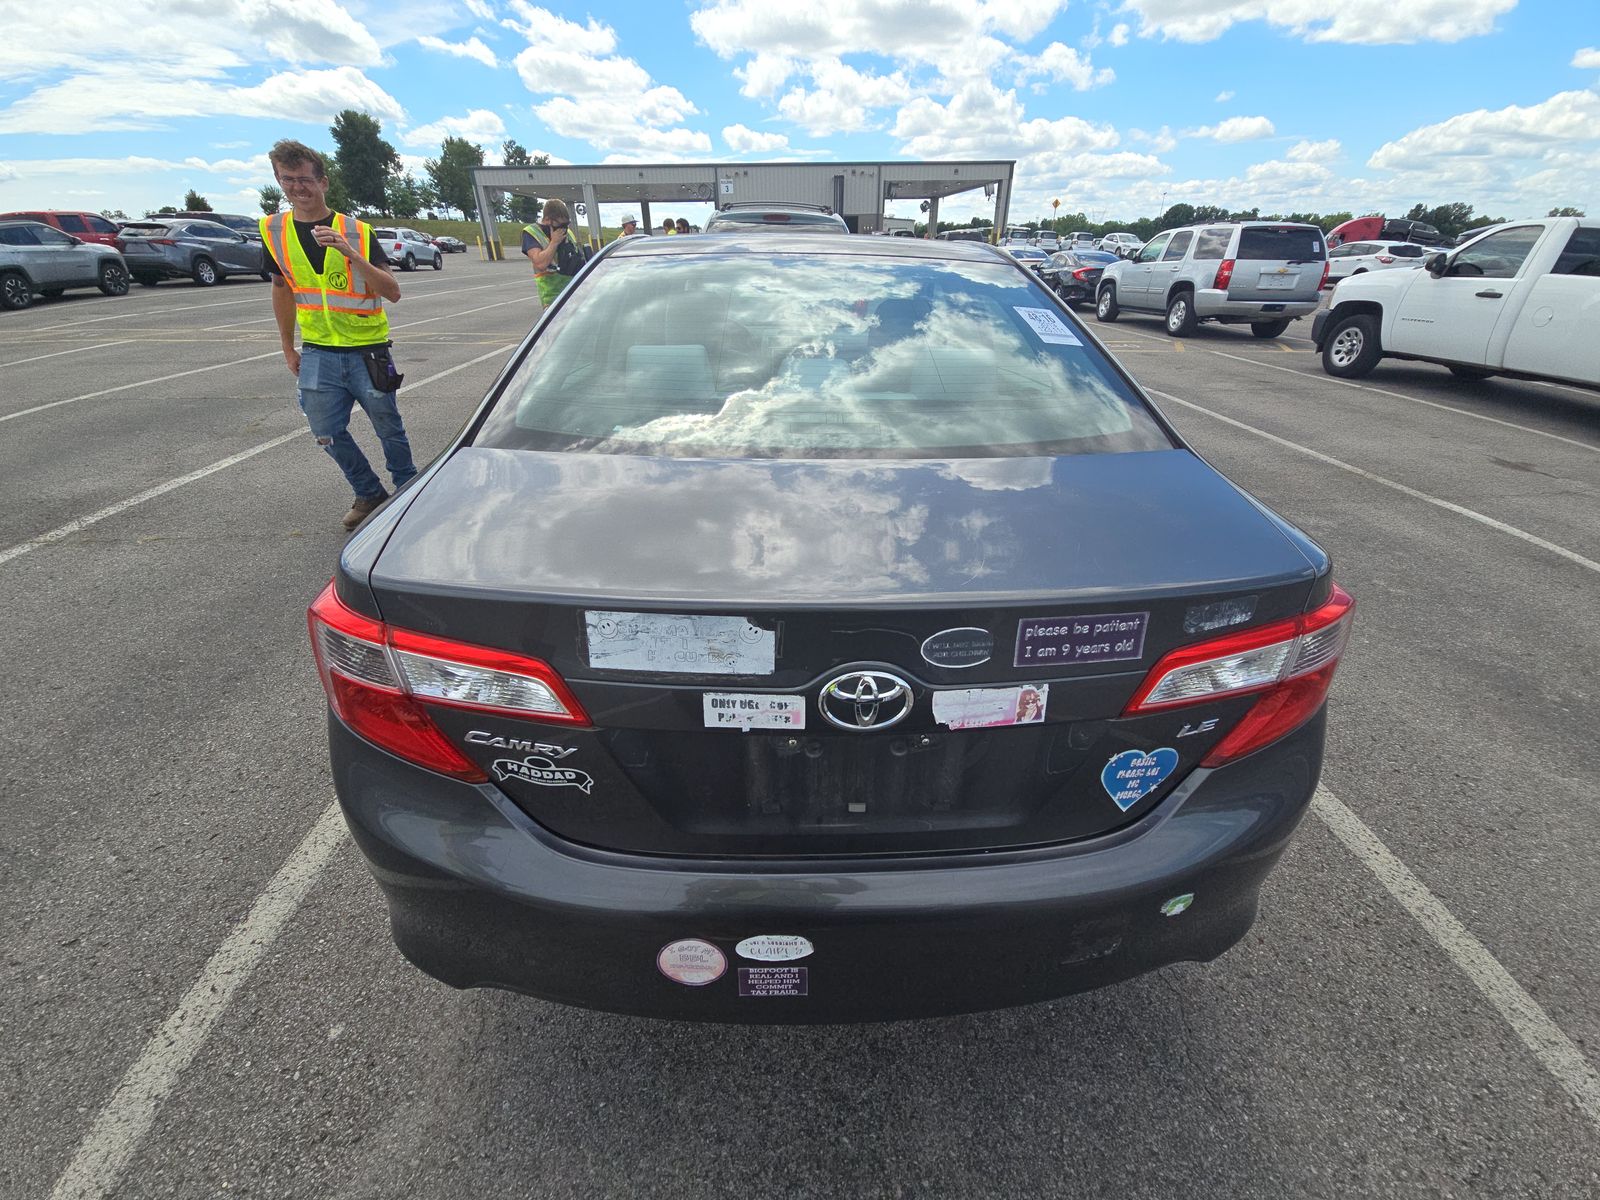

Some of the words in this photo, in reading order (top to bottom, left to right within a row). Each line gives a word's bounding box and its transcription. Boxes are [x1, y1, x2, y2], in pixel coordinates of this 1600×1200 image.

[725, 185, 729, 193] 3
[1025, 625, 1068, 640] please
[1073, 622, 1089, 634] be
[1094, 618, 1140, 637] patient
[1025, 646, 1032, 657] I
[1037, 646, 1056, 657] am
[1062, 644, 1070, 655] 9
[1076, 643, 1110, 657] years
[1115, 638, 1134, 652] old
[711, 698, 737, 709] ONLY
[1176, 718, 1219, 738] LE
[464, 730, 578, 759] CAMRY
[507, 762, 576, 780] HADDAD
